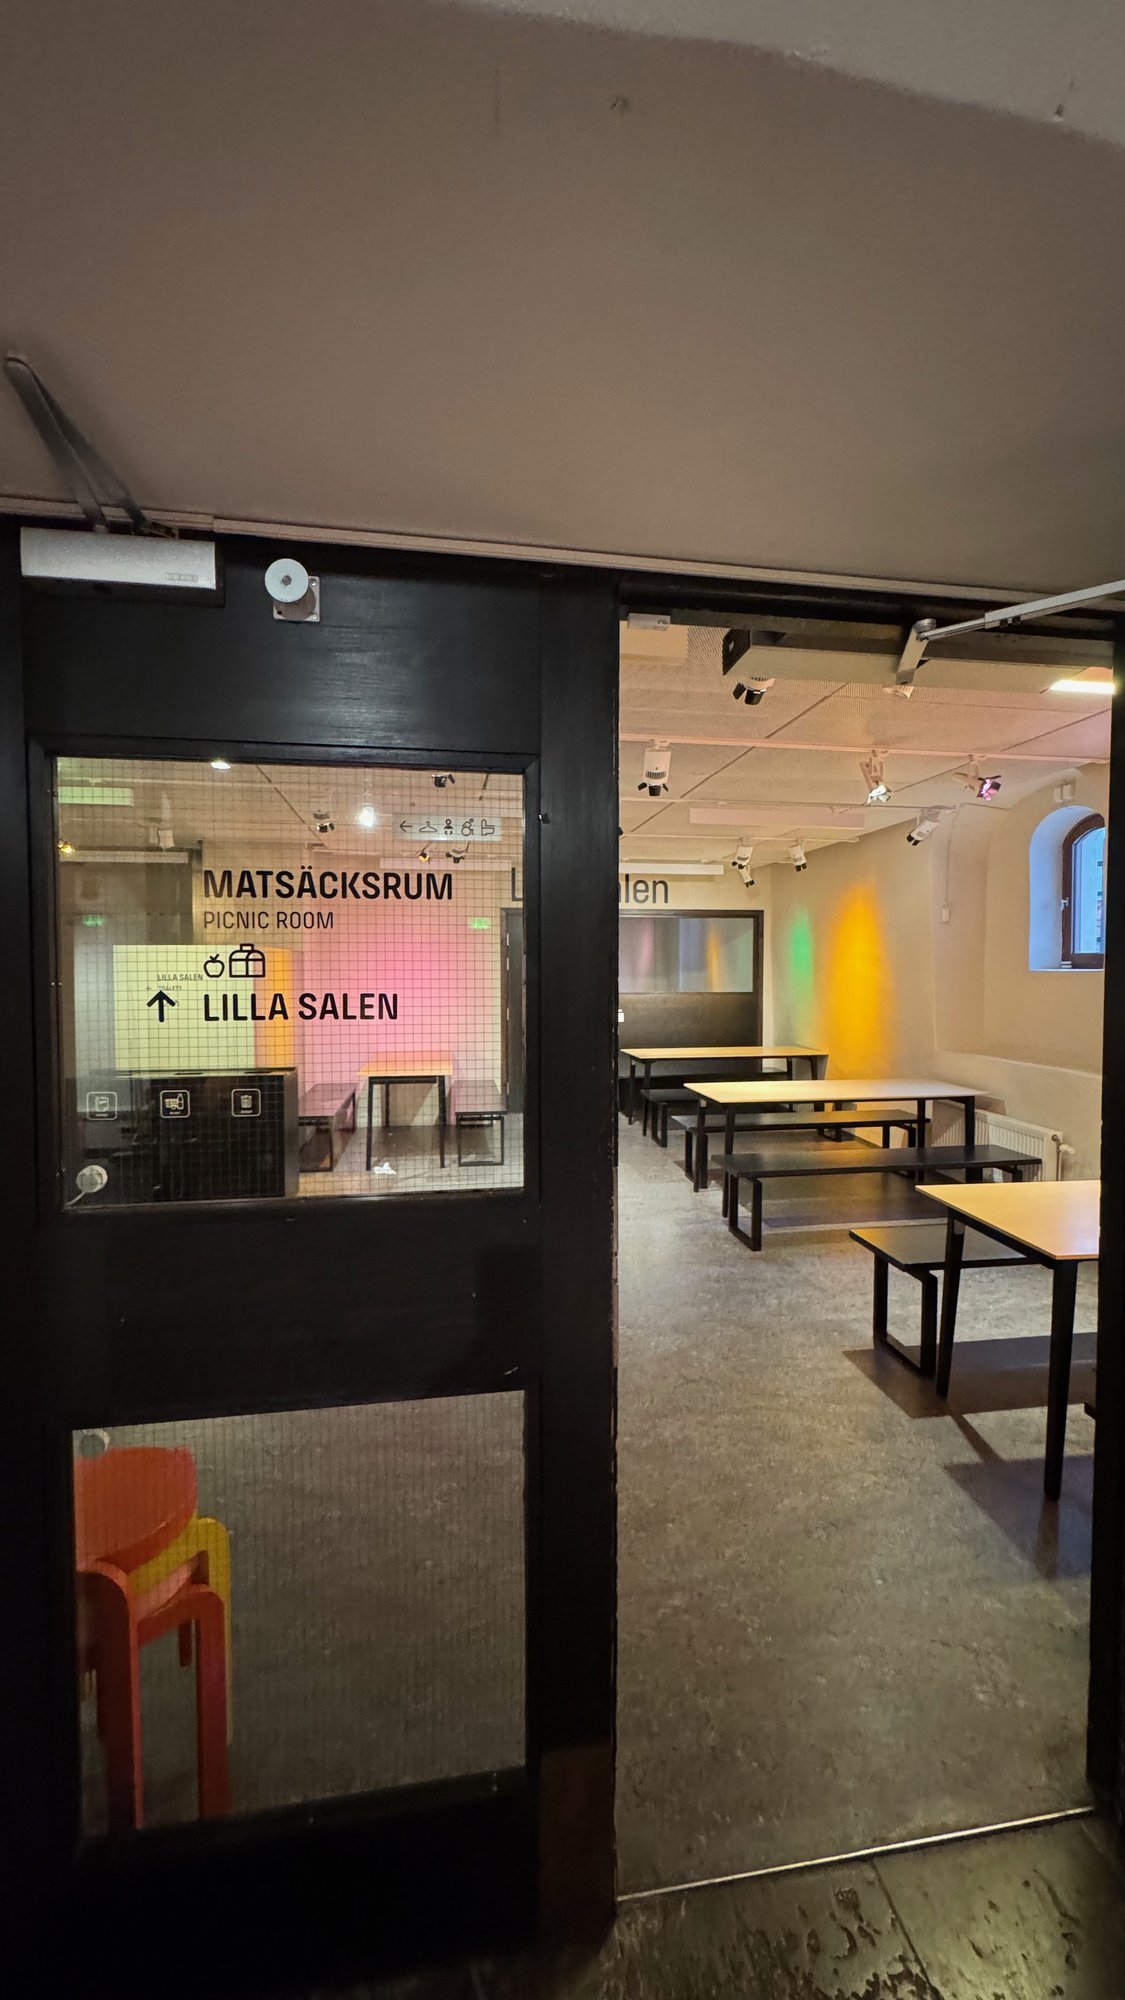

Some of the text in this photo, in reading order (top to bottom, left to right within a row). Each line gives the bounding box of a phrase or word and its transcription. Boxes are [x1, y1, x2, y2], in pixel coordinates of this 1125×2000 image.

[204, 865, 453, 900] MATSÄCKSRUM
[618, 873, 669, 904] len
[203, 911, 334, 930] PICNIC ROOM
[157, 973, 203, 982] LILLA SALEN
[203, 992, 398, 1022] LILLA SALEN
